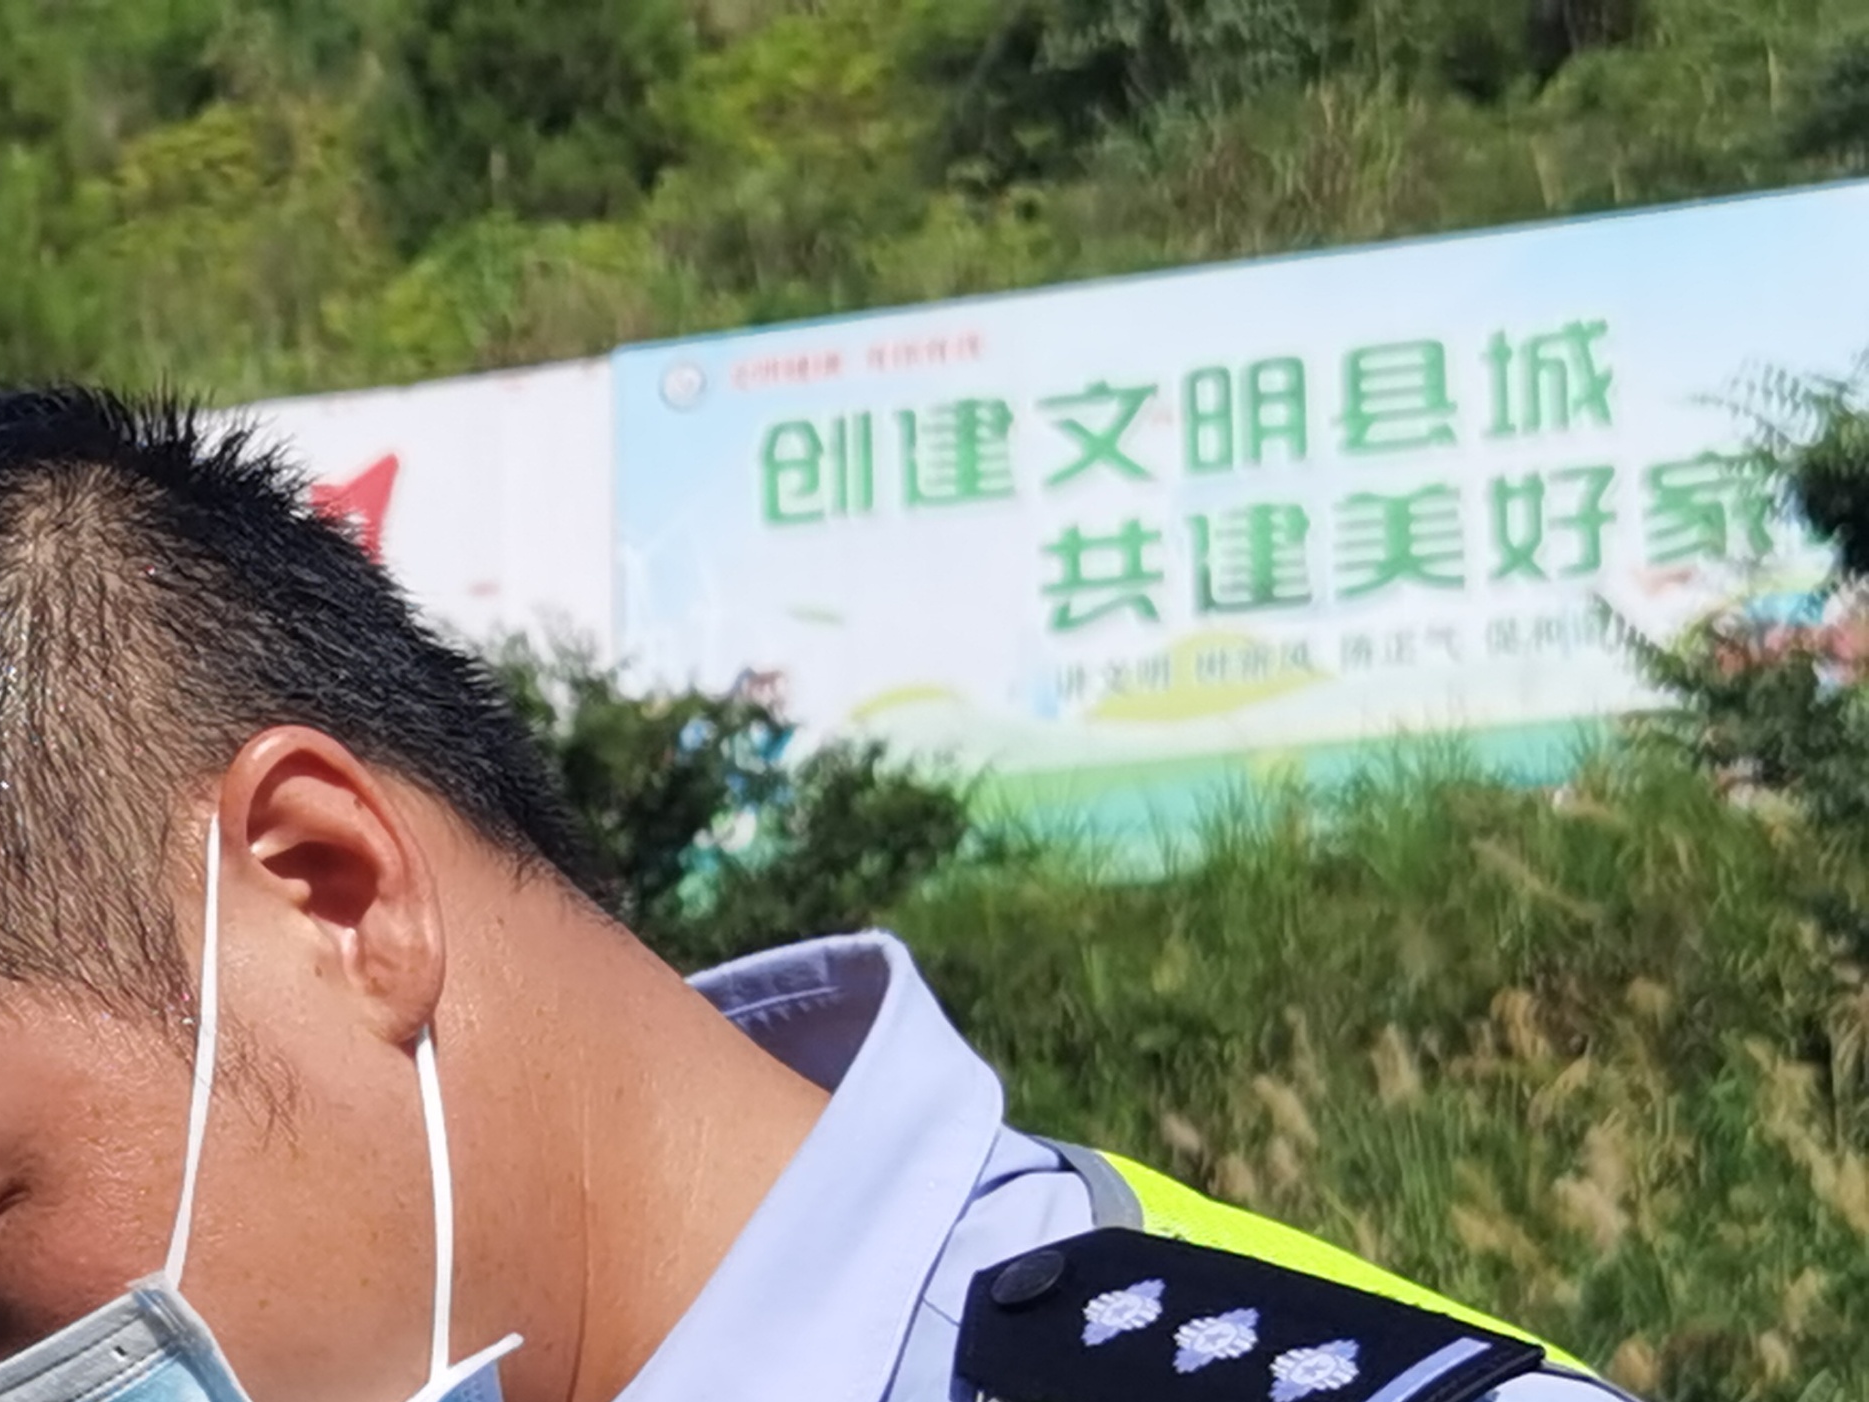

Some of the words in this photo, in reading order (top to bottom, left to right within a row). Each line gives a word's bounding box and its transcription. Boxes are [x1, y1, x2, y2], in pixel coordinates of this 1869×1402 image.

[760, 318, 1615, 526] 创建文明县城
[1041, 448, 1776, 633] 共建美好家
